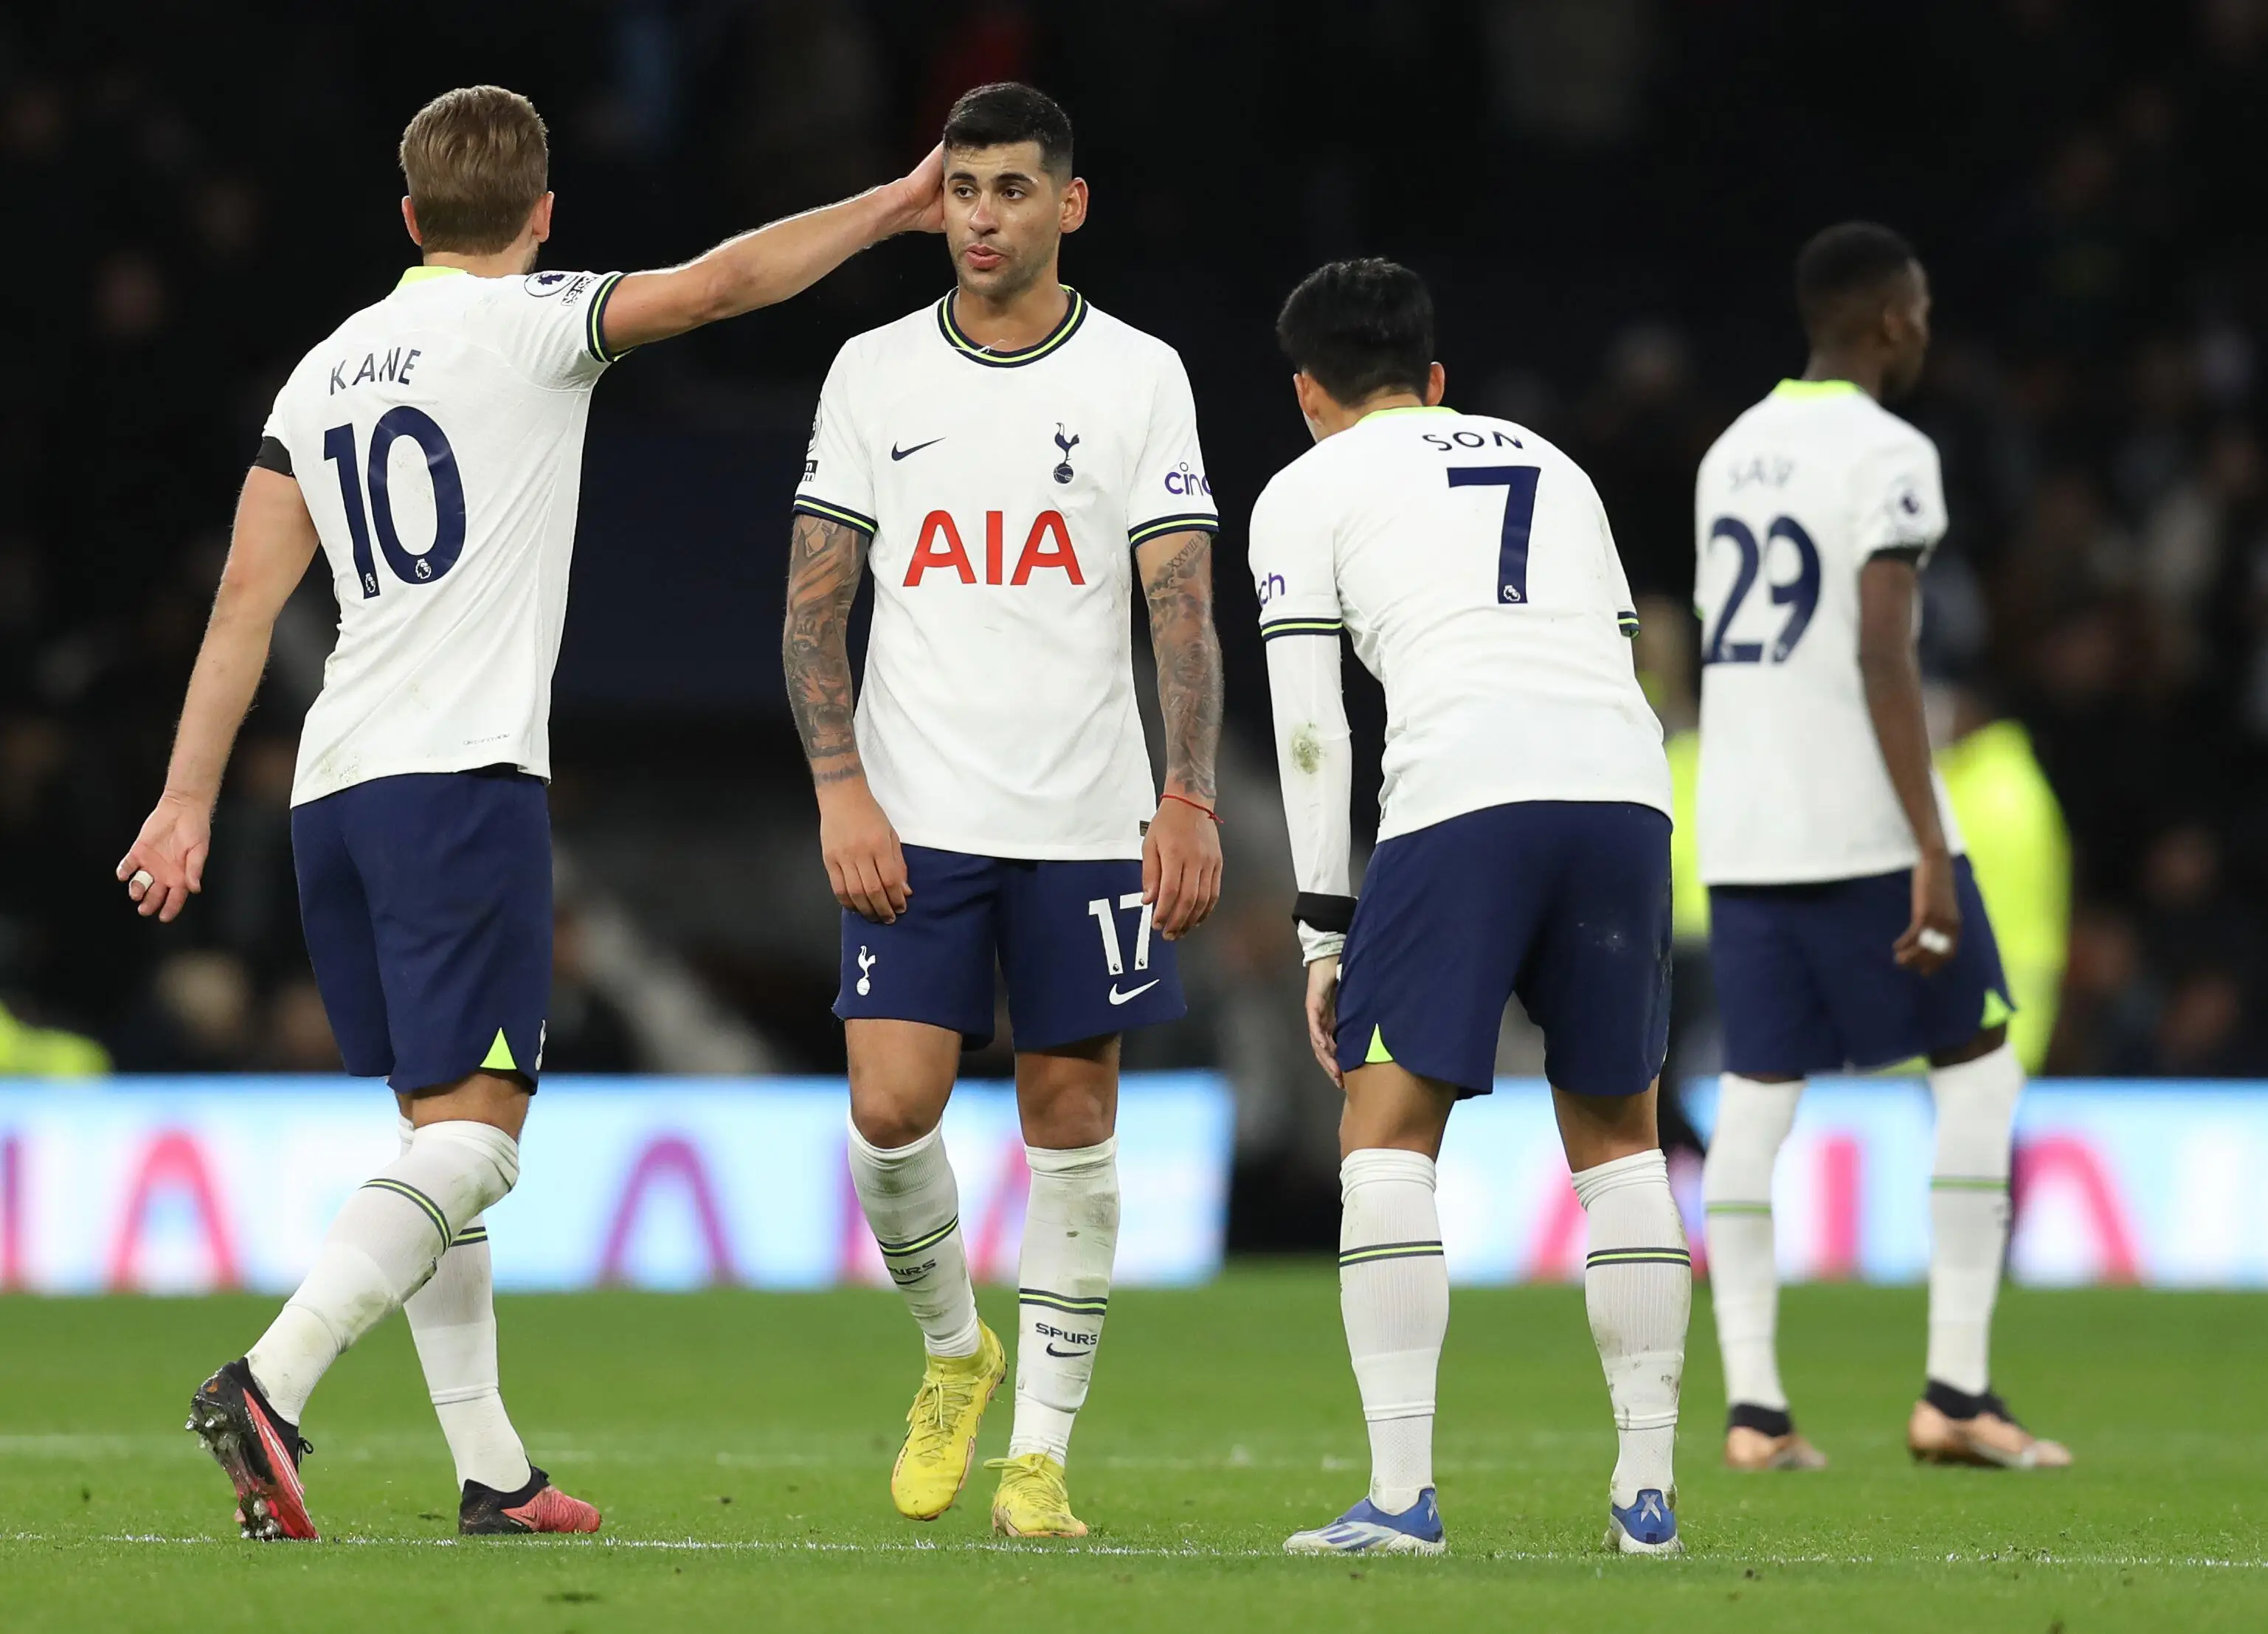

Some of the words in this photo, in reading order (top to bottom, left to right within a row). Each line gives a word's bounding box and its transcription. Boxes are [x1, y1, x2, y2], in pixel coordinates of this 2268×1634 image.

[330, 347, 421, 395] KANE
[1422, 431, 1524, 451] SON
[323, 405, 466, 599] 10
[1446, 465, 1541, 604] 7
[903, 509, 1085, 587] AIA
[1703, 516, 1822, 664] 29
[1088, 891, 1154, 975] 17
[1035, 1323, 1098, 1346] SPURS
